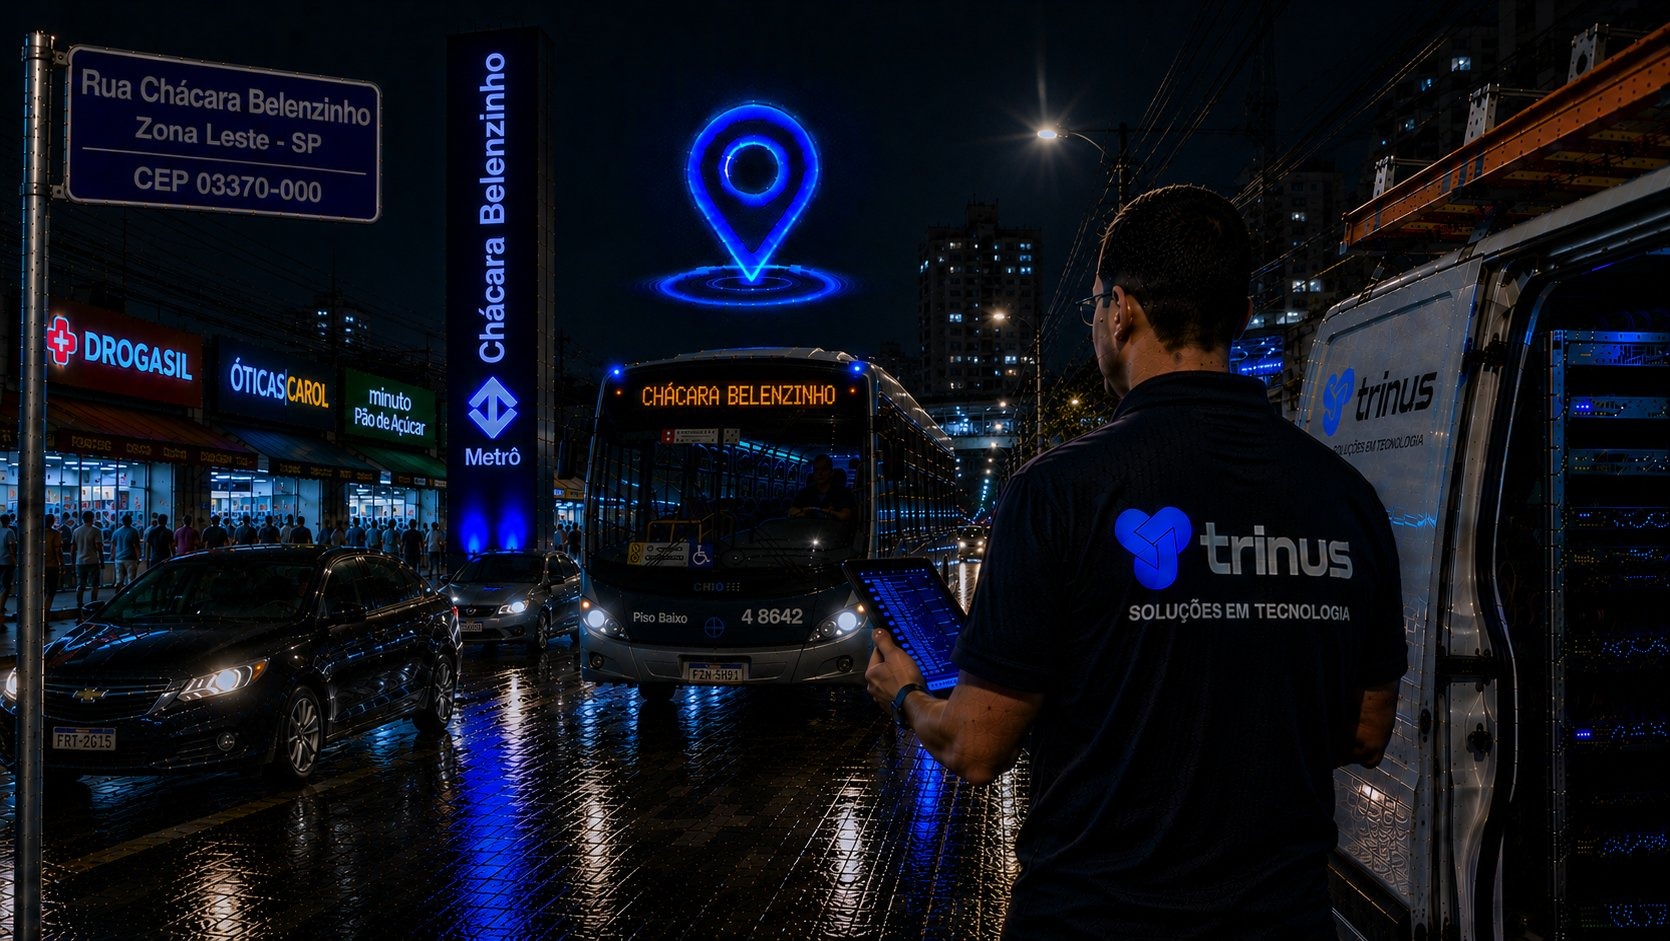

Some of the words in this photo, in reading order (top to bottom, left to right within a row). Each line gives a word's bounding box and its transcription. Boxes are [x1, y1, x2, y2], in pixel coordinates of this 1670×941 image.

[81, 68, 132, 100] Rua
[140, 75, 242, 113] Chácara
[248, 88, 371, 127] Belenzinho
[135, 115, 198, 144] Zona
[206, 122, 270, 151] Leste
[291, 132, 322, 154] SP
[479, 52, 506, 226] Belenzinho
[133, 166, 190, 192] CEP
[196, 171, 322, 203] 03370-000
[478, 237, 506, 364] Chácara
[84, 330, 193, 381] DROGASIL
[369, 387, 412, 412] minuto
[642, 381, 720, 406] CHÁCARA
[727, 384, 836, 406] BELENZINHO
[1356, 371, 1437, 421] trinus
[354, 407, 375, 428] Pão
[376, 412, 390, 430] de
[391, 416, 426, 437] Açúcar
[465, 446, 521, 467] Metrô
[1376, 434, 1424, 451] TECNOLOGIA
[1200, 522, 1353, 580] trinus
[633, 611, 655, 624] Piso
[658, 611, 688, 624] Baixo
[741, 608, 753, 624] 4
[757, 608, 803, 625] 8642
[1128, 598, 1222, 624] SOLUÇÕES
[1225, 603, 1250, 619] EM
[1254, 603, 1350, 622] TECNOLOGIA
